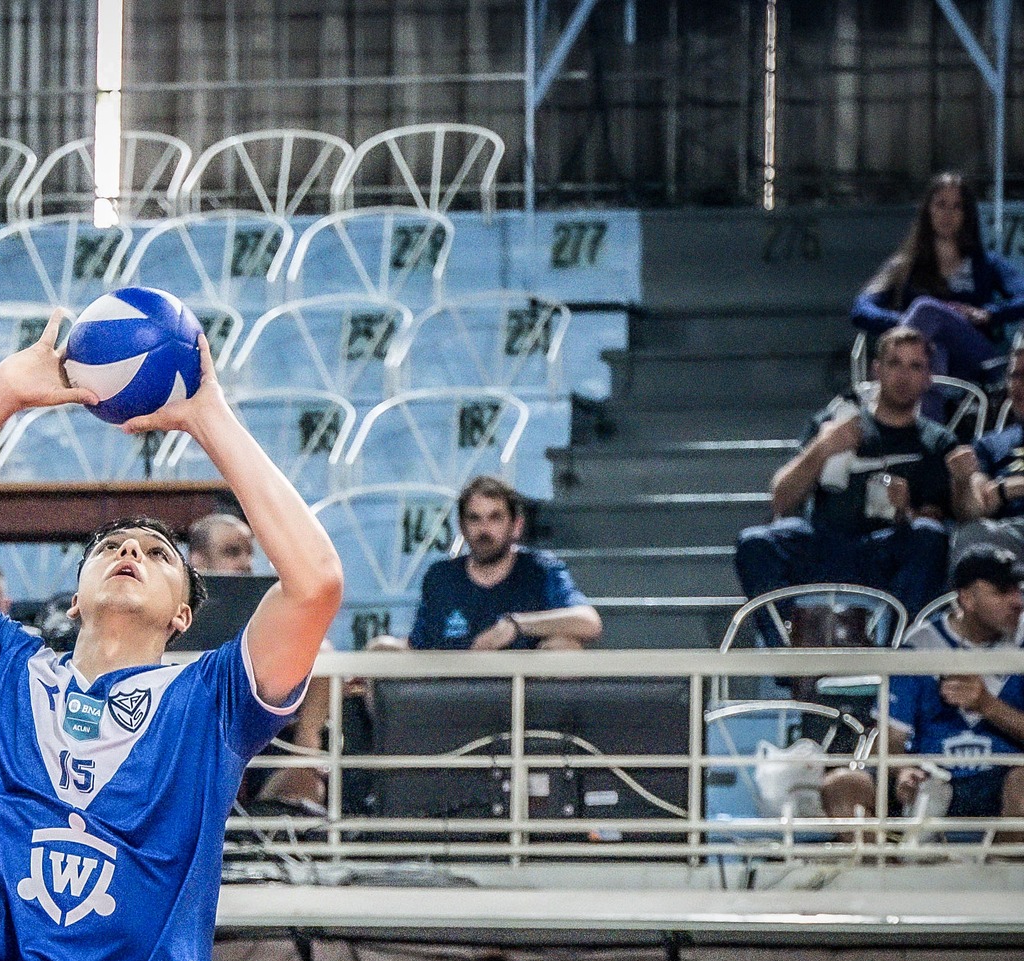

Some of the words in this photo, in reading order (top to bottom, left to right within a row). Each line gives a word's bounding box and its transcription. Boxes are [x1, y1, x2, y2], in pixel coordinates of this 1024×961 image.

[550, 220, 608, 268] 277
[81, 705, 101, 717] BNA
[58, 750, 96, 794] 15
[49, 850, 98, 897] W
